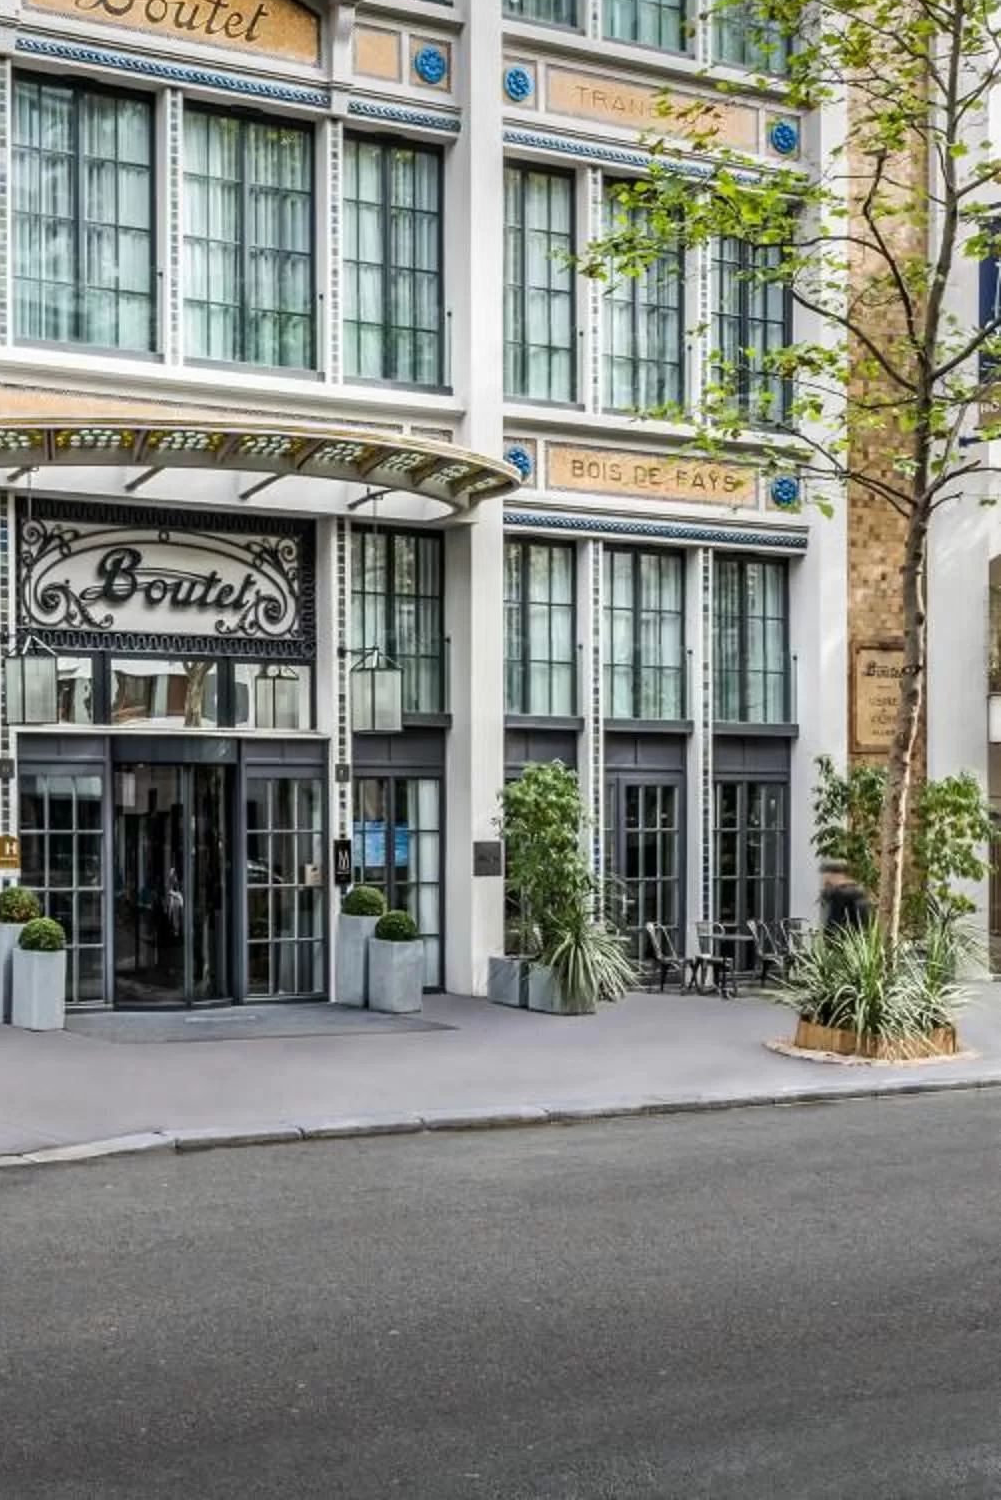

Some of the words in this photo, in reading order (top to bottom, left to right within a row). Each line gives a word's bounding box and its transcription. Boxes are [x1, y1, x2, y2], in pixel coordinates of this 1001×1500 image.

[571, 459, 622, 482] BOIS
[634, 465, 662, 488] DE
[80, 548, 256, 609] Boutet
